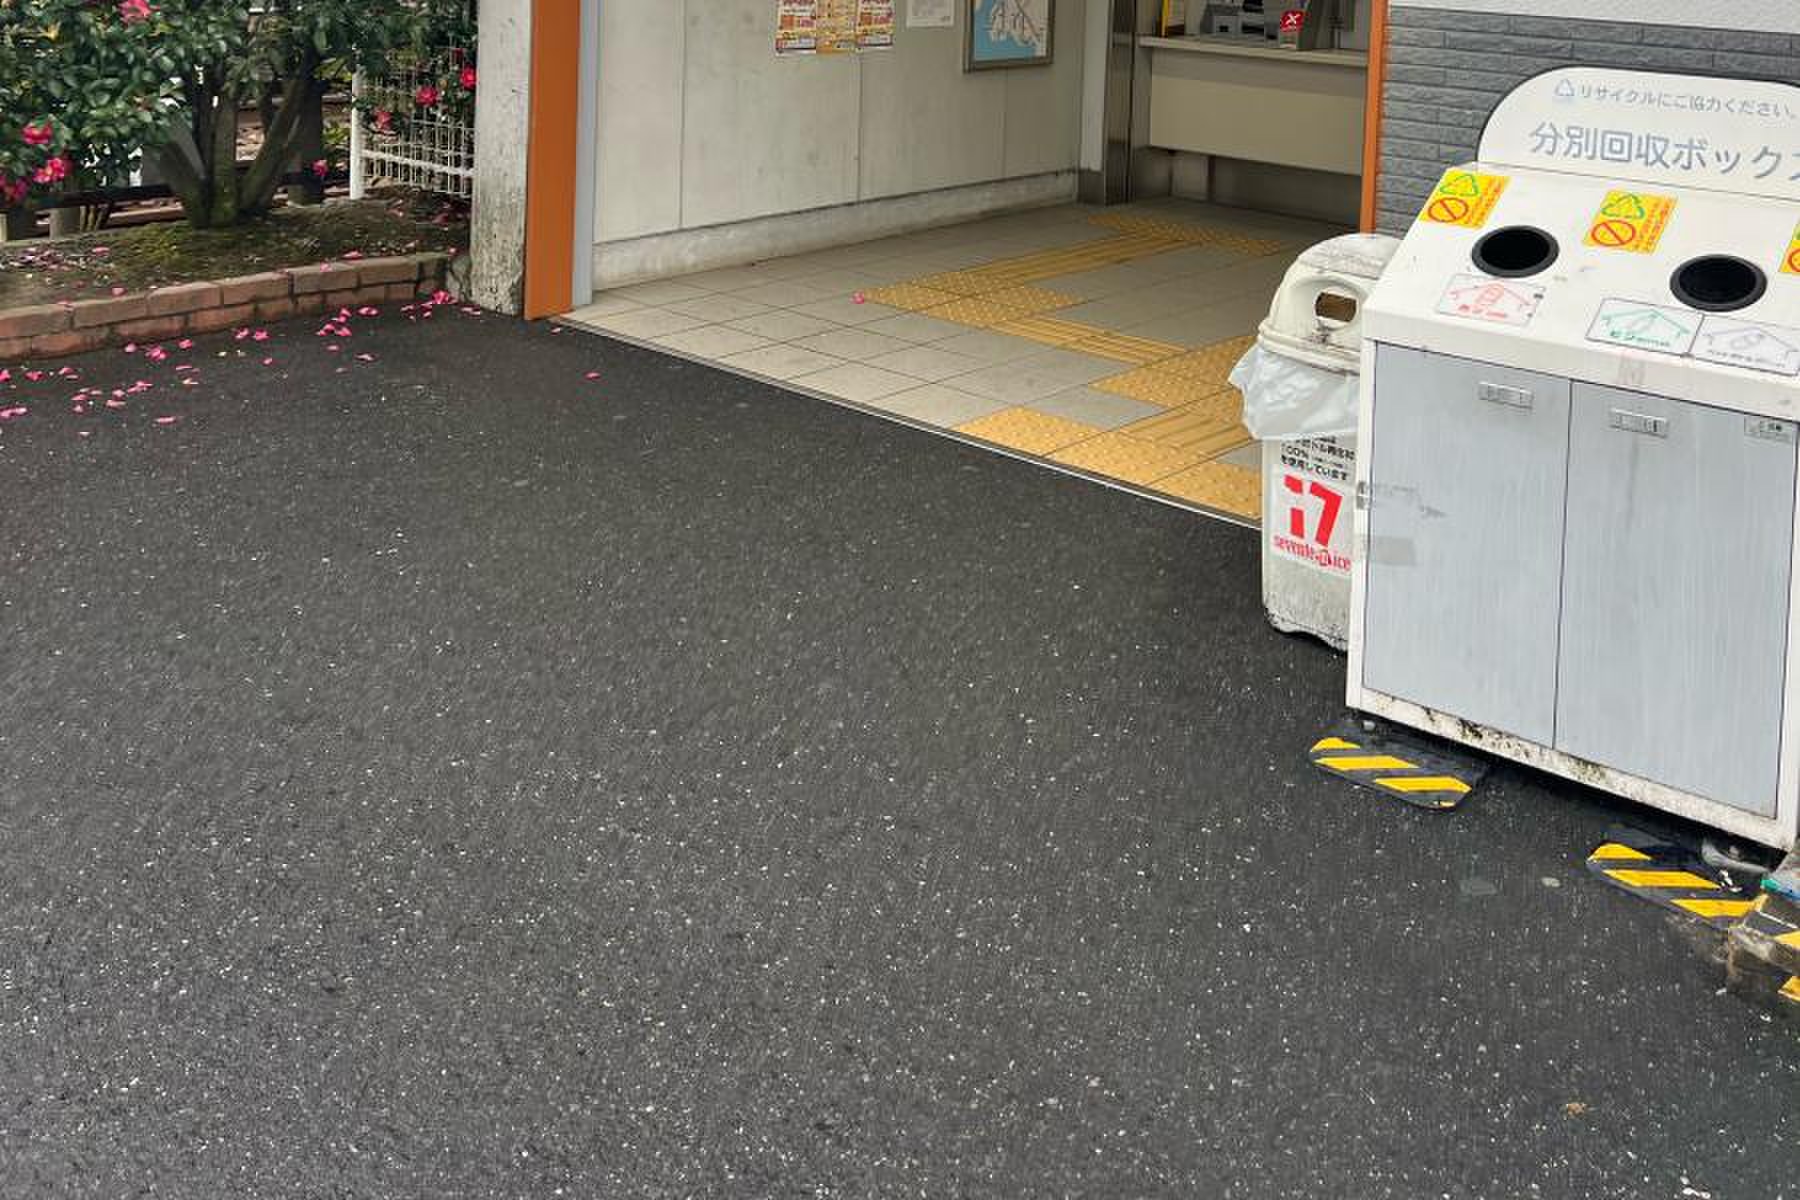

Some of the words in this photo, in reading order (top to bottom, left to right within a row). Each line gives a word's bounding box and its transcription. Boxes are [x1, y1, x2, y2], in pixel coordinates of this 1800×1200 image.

[1580, 83, 1797, 120] リサイクルにご協力ください。
